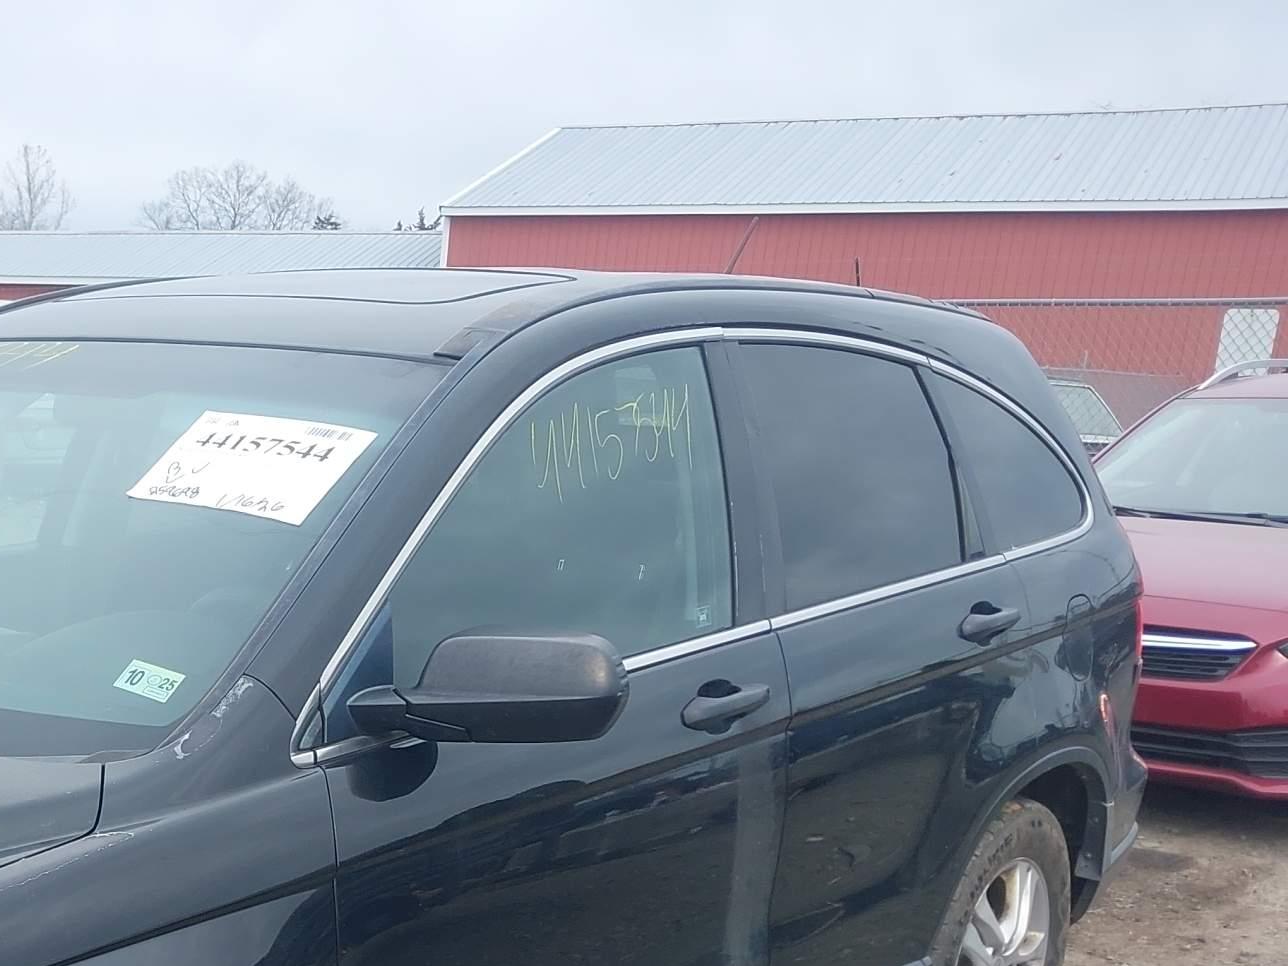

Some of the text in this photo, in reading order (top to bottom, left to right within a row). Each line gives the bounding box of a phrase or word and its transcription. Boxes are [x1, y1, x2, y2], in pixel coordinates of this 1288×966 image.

[196, 432, 336, 462] 44157544
[531, 383, 692, 504] 44157544
[125, 668, 178, 691] 10 25
